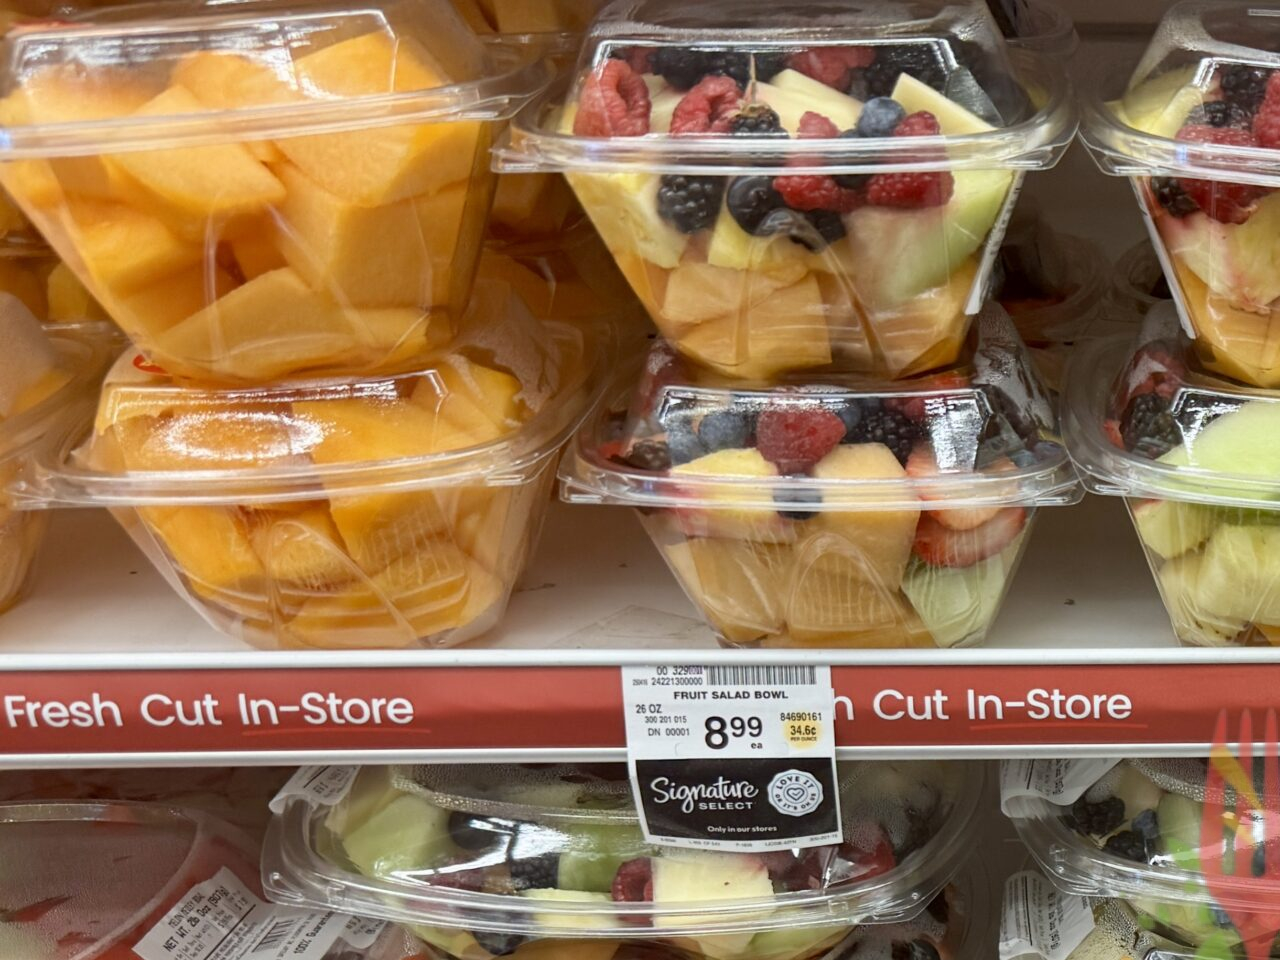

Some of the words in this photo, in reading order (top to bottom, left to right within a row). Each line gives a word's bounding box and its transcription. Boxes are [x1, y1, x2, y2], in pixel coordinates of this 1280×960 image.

[674, 691, 708, 699] FRUIT
[712, 691, 750, 699] SALAD
[755, 691, 788, 699] BOWL
[873, 689, 949, 720] Cut
[967, 688, 1132, 720] In-Store
[4, 693, 124, 728] Fresh
[140, 693, 222, 726] Cut
[238, 692, 414, 726] In-Store
[636, 704, 646, 714] 26
[649, 704, 662, 713] OZ
[780, 712, 822, 721] 84690161
[648, 728, 660, 736] DN
[666, 728, 689, 736] 00001
[777, 775, 801, 790] LOVE
[803, 778, 814, 789] IT
[650, 776, 759, 813] Signature
[699, 802, 753, 810] SELECT
[707, 825, 726, 834] Only
